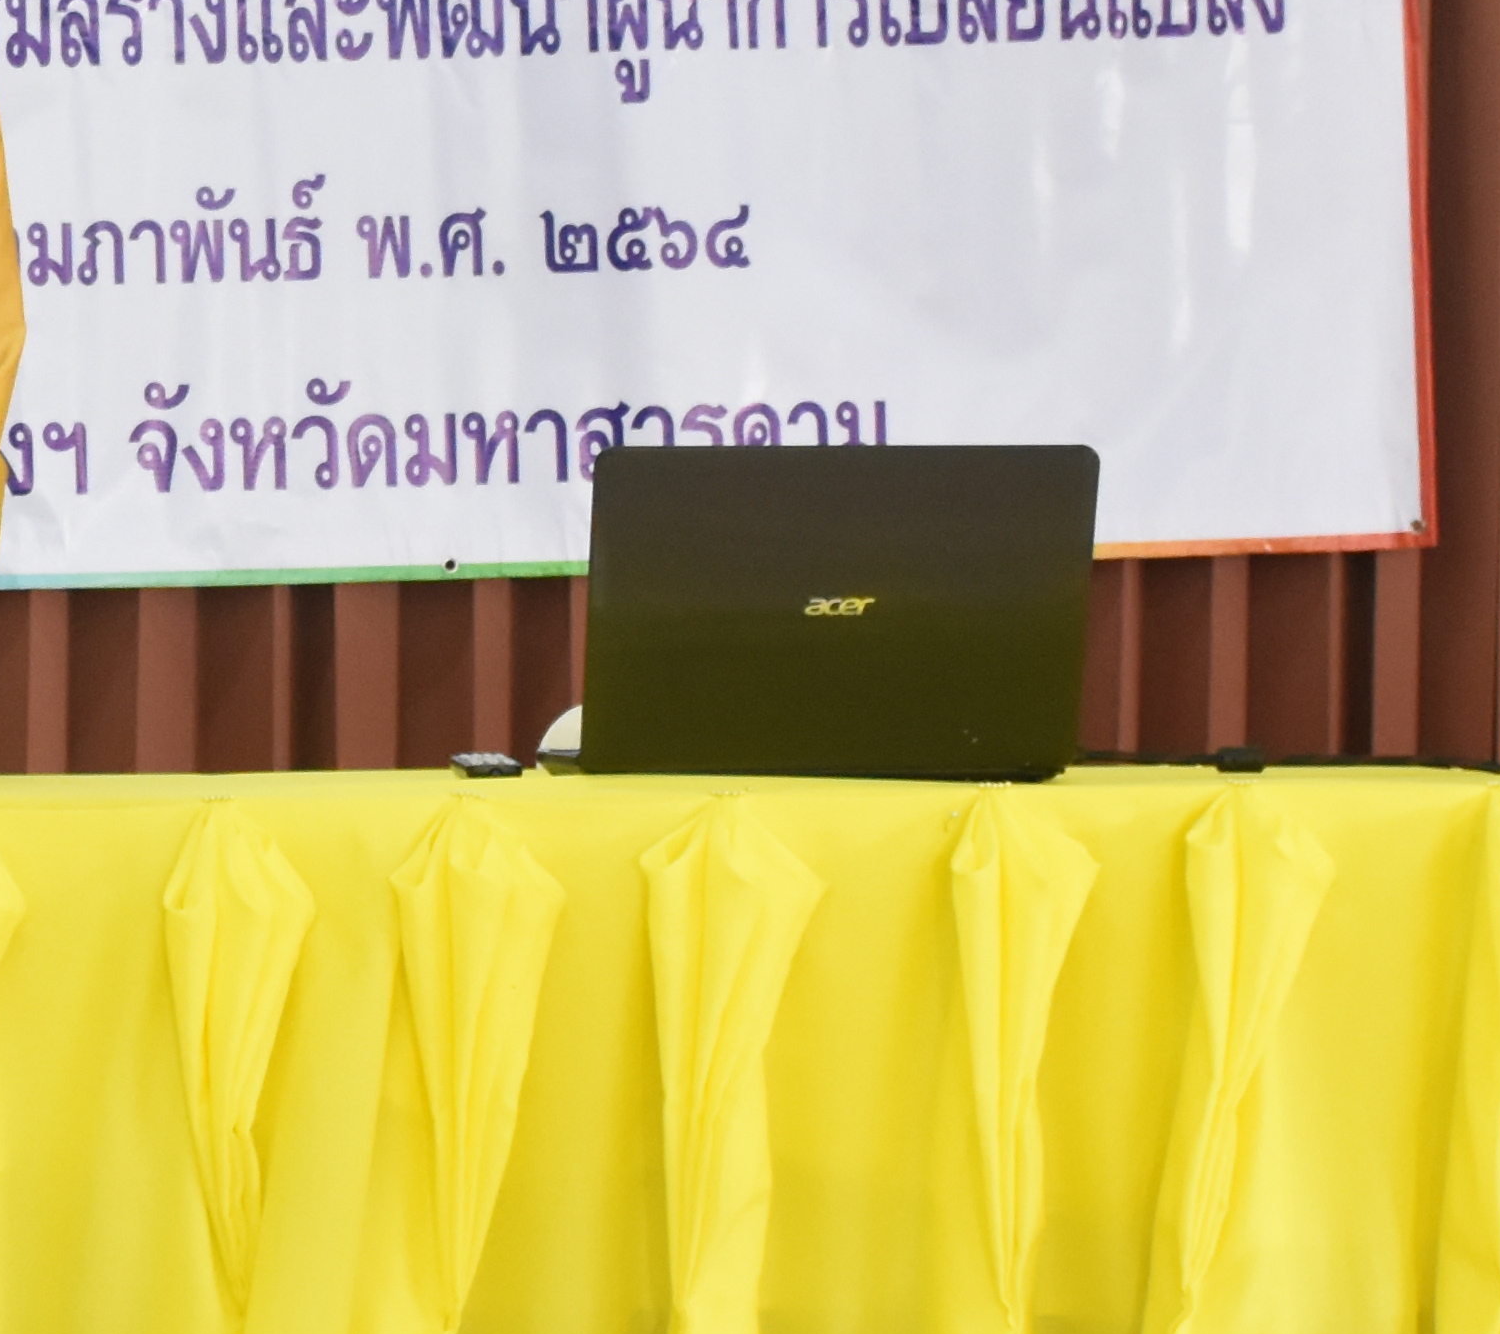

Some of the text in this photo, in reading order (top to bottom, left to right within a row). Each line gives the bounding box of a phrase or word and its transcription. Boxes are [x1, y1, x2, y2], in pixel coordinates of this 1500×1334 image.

[12, 173, 326, 286] มภาพันธ์
[357, 208, 505, 278] พ.ศ.
[542, 205, 751, 274] ๒๕๖๔
[804, 597, 875, 616] acer
